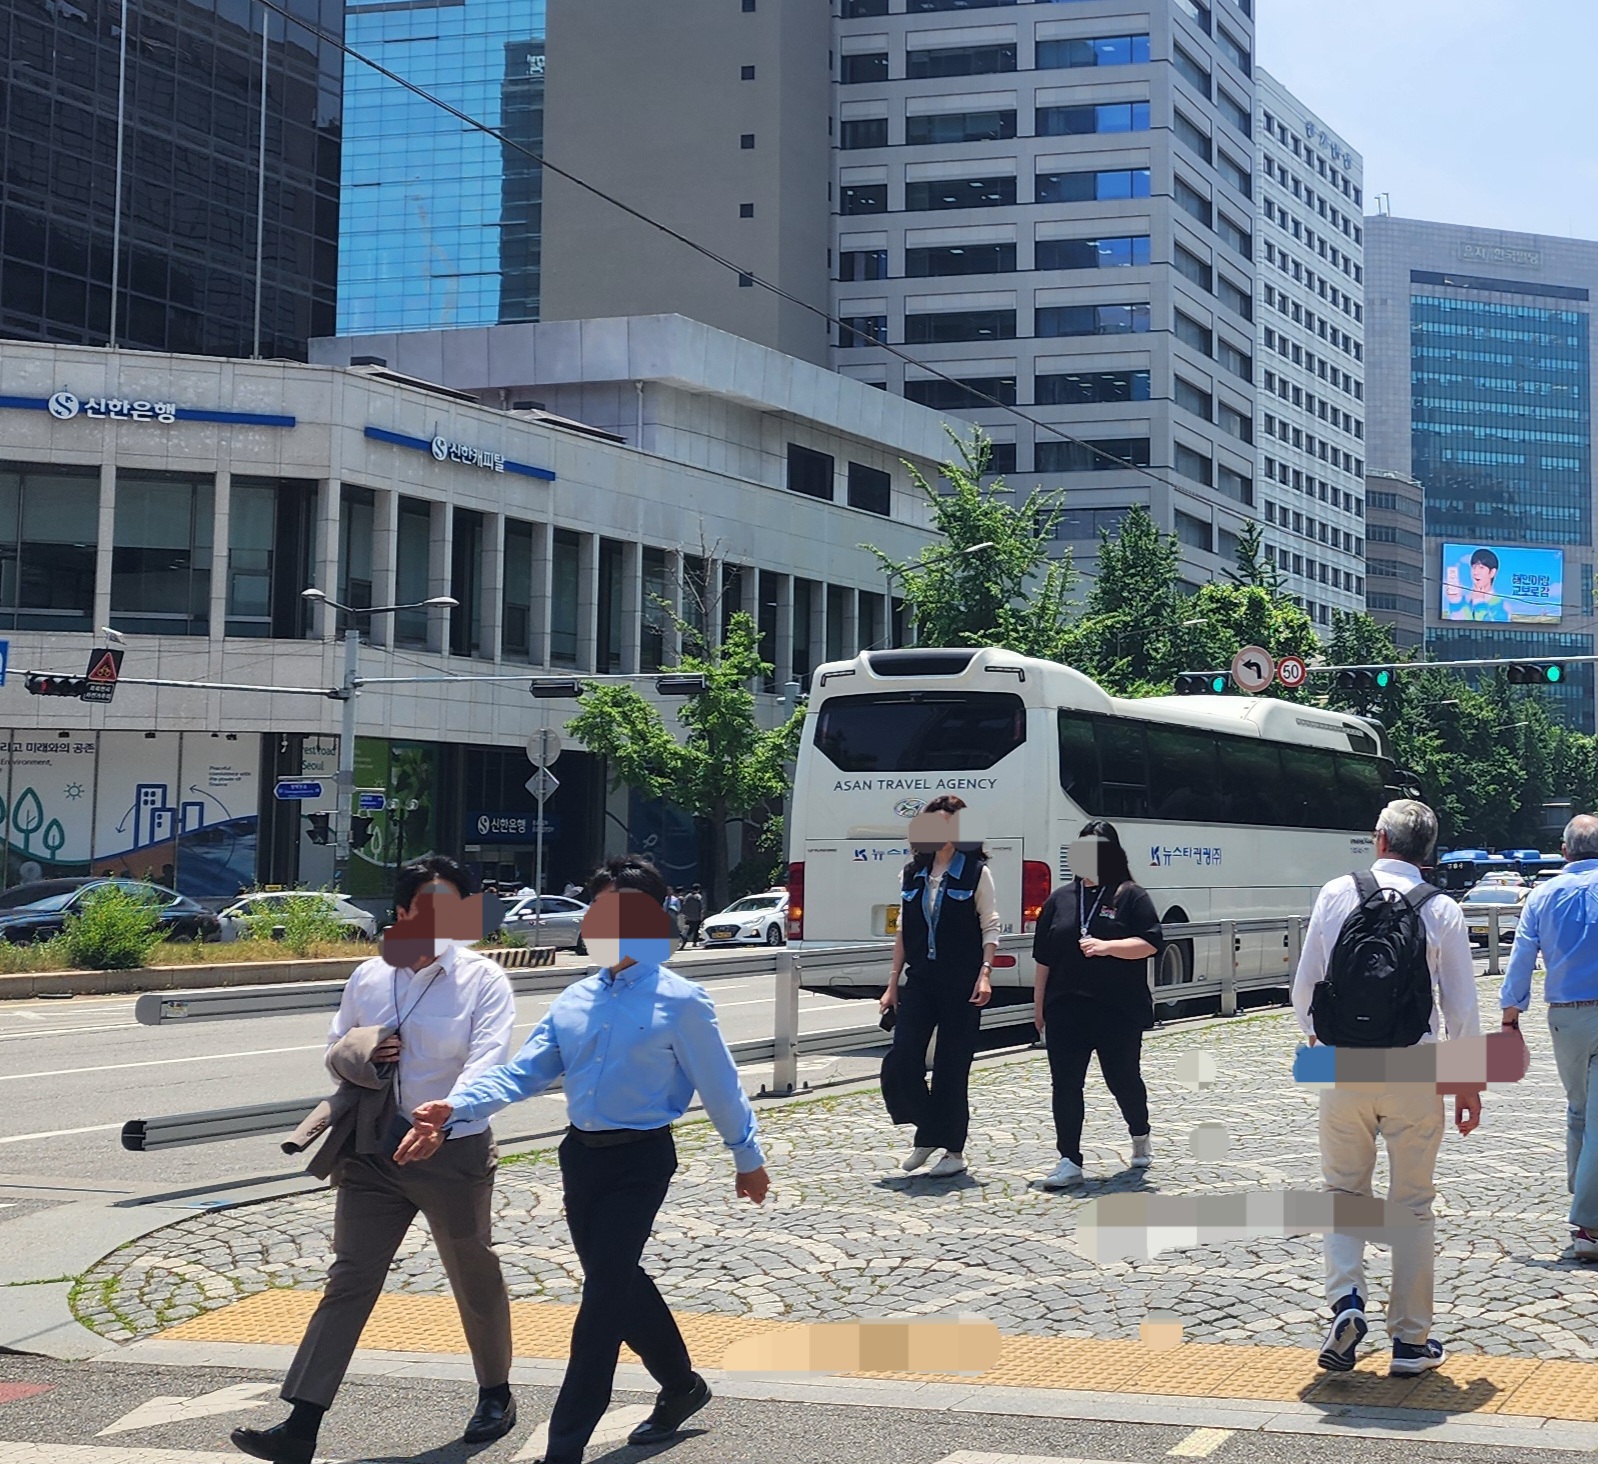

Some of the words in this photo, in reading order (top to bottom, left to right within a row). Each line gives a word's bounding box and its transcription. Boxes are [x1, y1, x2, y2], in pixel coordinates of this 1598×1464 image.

[84, 397, 176, 424] 신한은행
[449, 442, 505, 473] 신한캐피탈
[1282, 664, 1299, 680] 50
[25, 742, 70, 753] 미래와의
[833, 780, 872, 791] ASAN
[876, 779, 932, 790] TRAVEL
[935, 778, 998, 790] AGENCY
[490, 817, 526, 834] 신한은행
